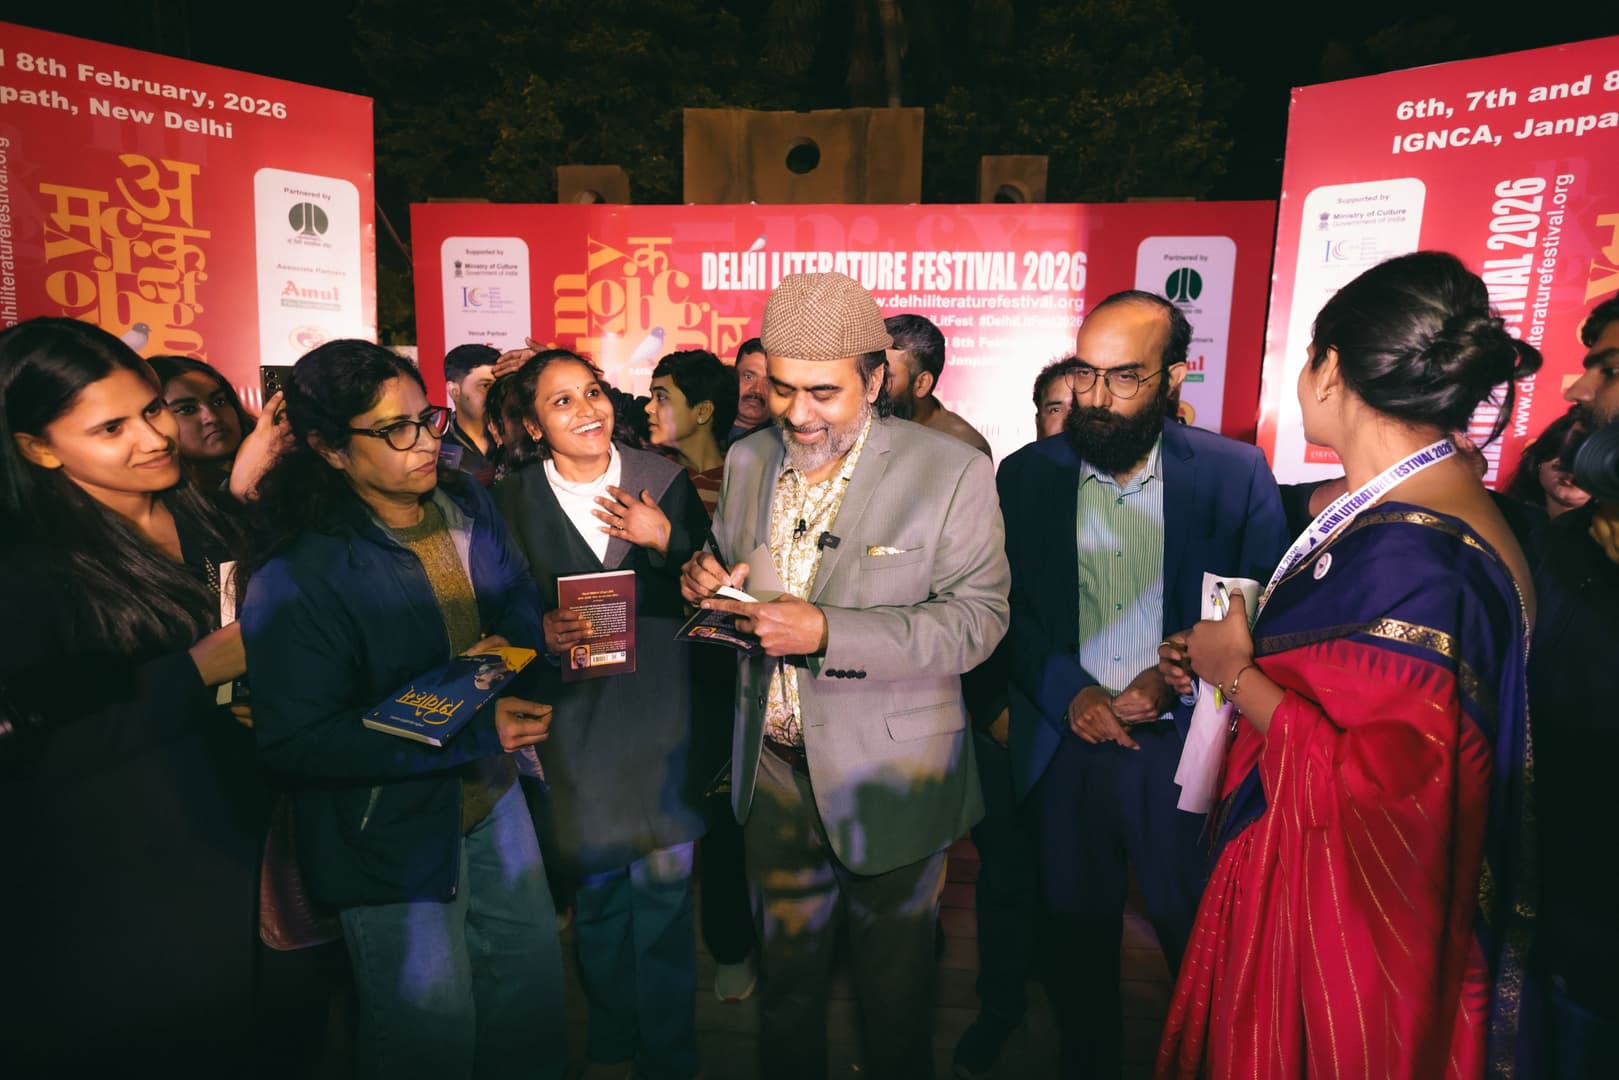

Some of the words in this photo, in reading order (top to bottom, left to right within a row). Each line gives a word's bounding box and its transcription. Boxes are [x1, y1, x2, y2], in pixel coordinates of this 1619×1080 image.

[16, 52, 67, 79] 8th
[78, 64, 215, 109] February,
[223, 92, 287, 120] 2026
[1396, 97, 1454, 120] 6th,
[1466, 87, 1517, 112] 7th
[1527, 74, 1592, 103] and
[89, 98, 156, 125] New
[164, 110, 233, 139] Delhi
[1392, 124, 1502, 154] IGNCA,
[1377, 209, 1407, 217] Culture
[1486, 177, 1547, 251] 2026
[281, 280, 340, 301] Amul
[702, 252, 766, 290] DELHI
[911, 251, 1017, 291] FESTIVAL
[1022, 251, 1087, 291] 2026
[875, 294, 1084, 312] w.delhiliteraturefestival.org
[1482, 253, 1534, 340] TIVAL
[1318, 512, 1344, 534] DELHI
[1432, 442, 1453, 458] 2026
